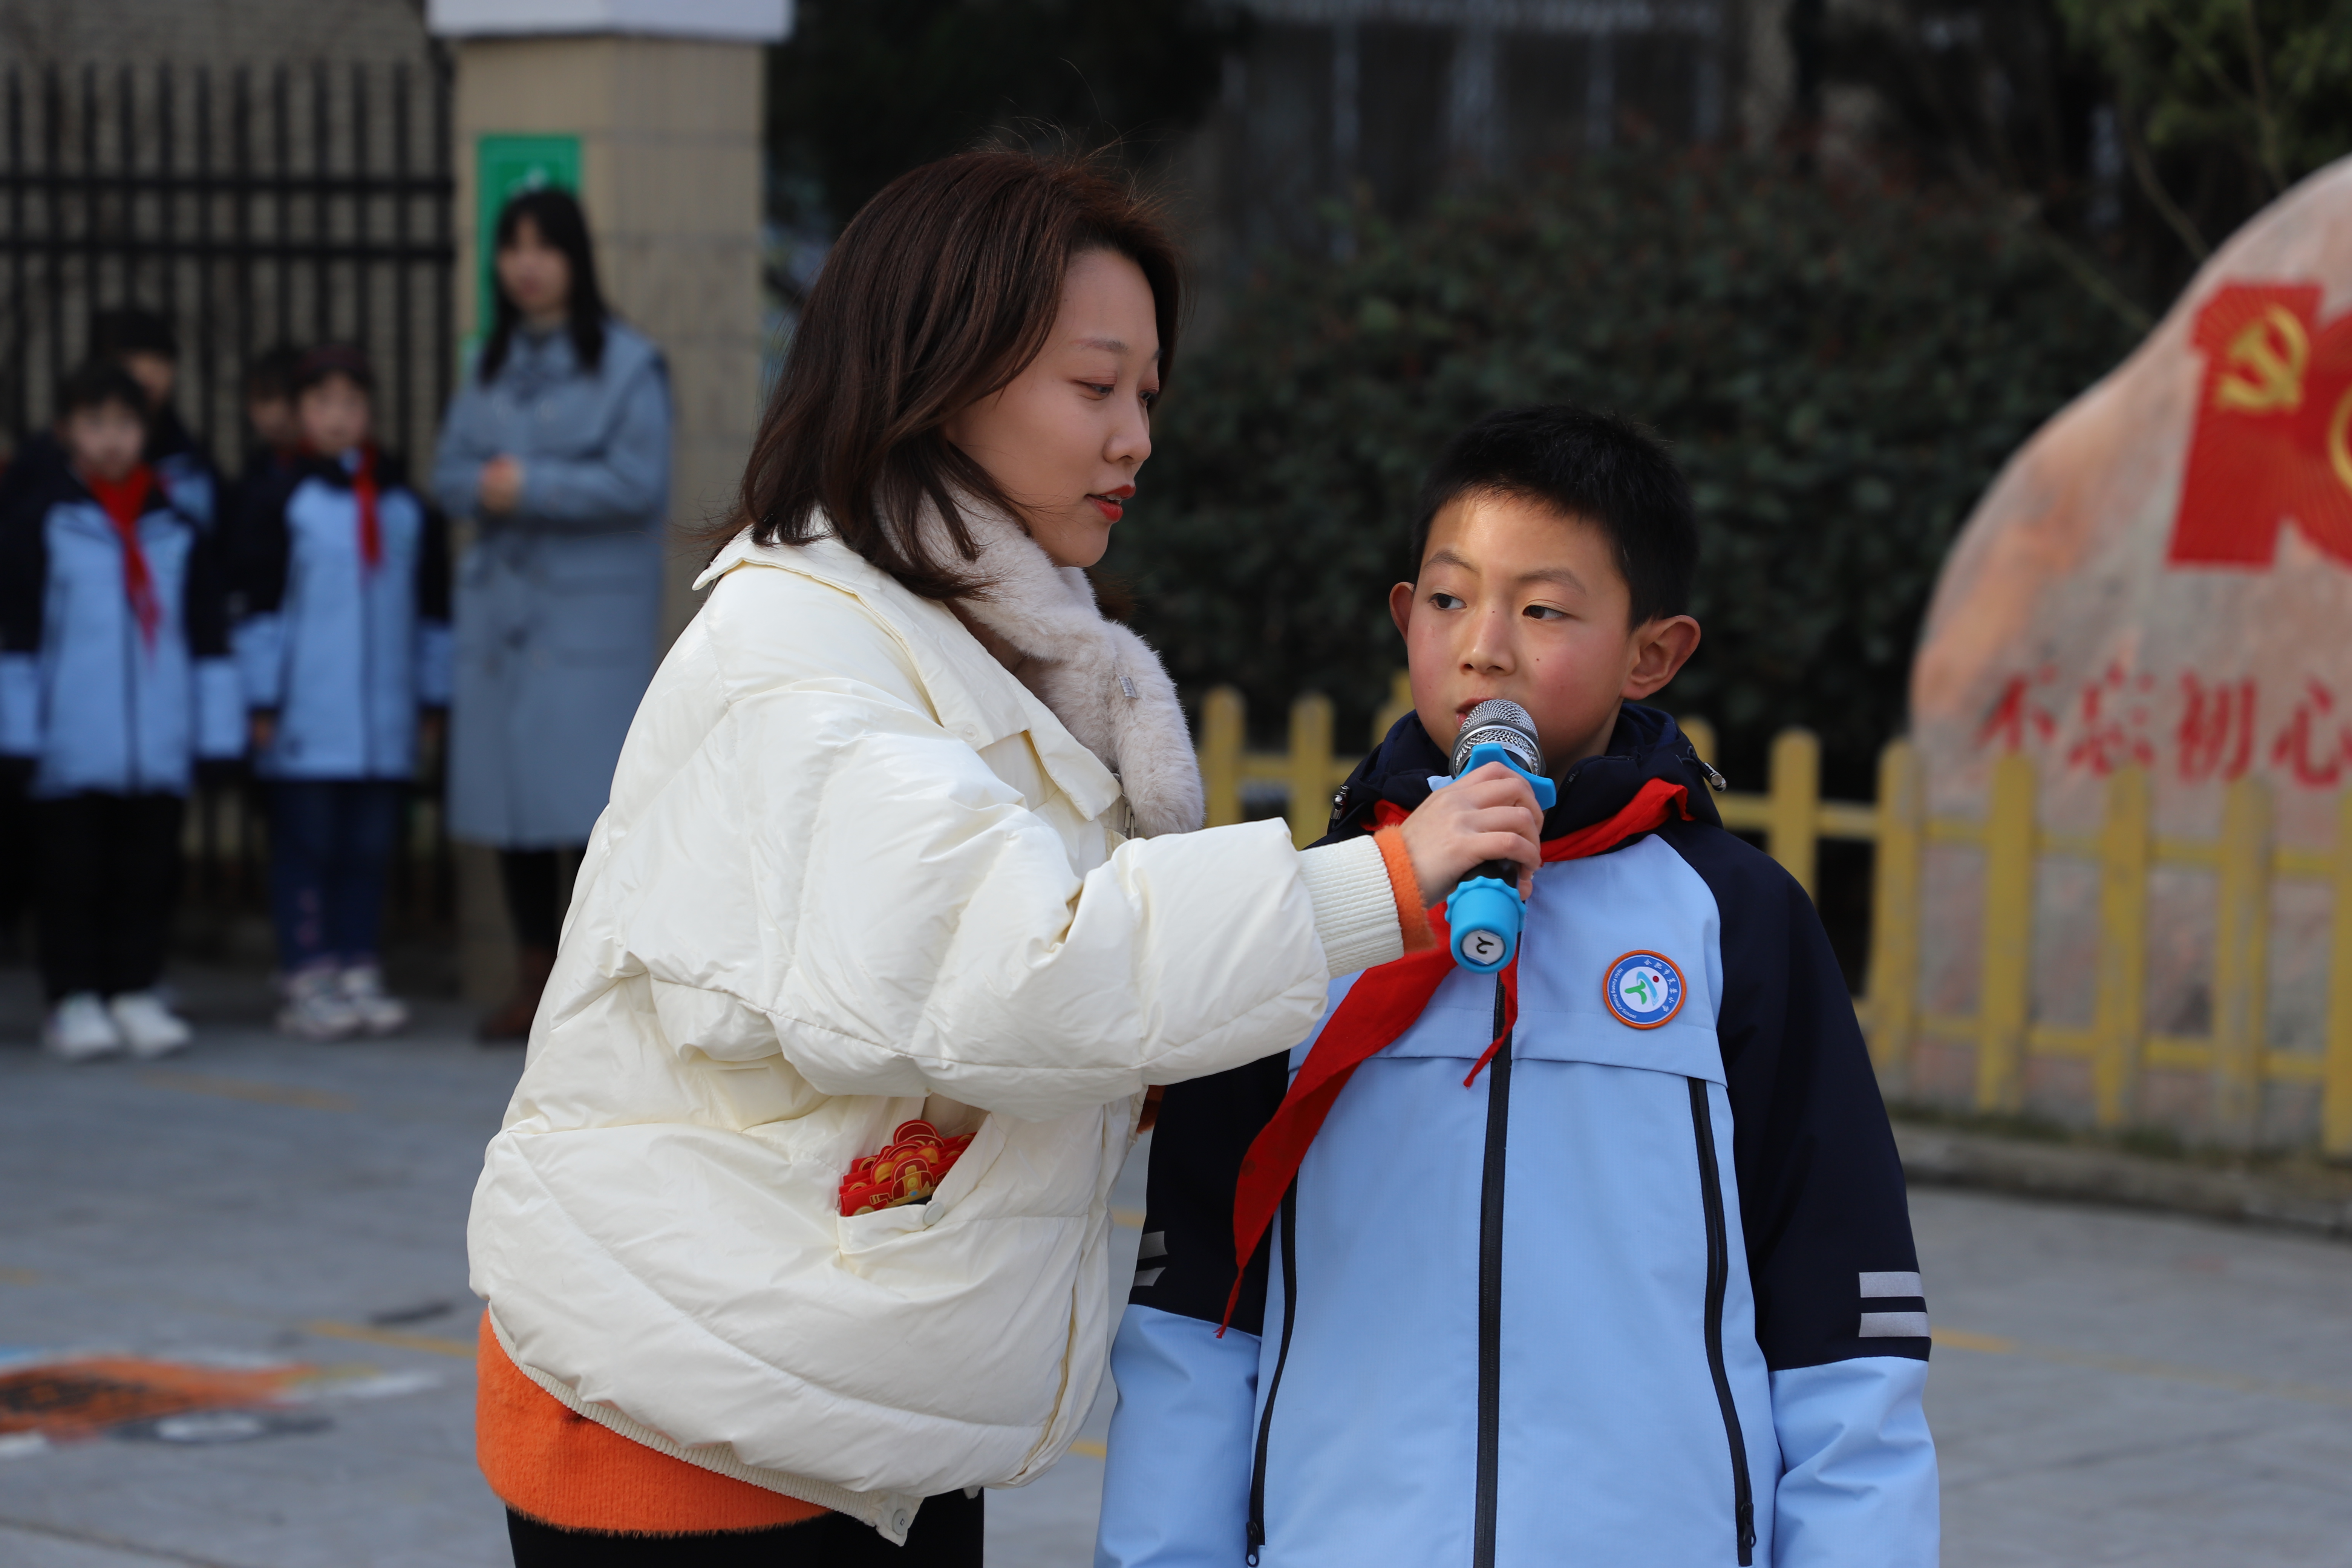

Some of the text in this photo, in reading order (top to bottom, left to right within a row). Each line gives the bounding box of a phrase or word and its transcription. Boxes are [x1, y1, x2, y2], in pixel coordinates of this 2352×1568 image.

[1974, 662, 2352, 789] 不忘初心
[1614, 968, 1623, 979] Hefei
[1612, 994, 1623, 1010] Primary
[1622, 1008, 1637, 1019] School
